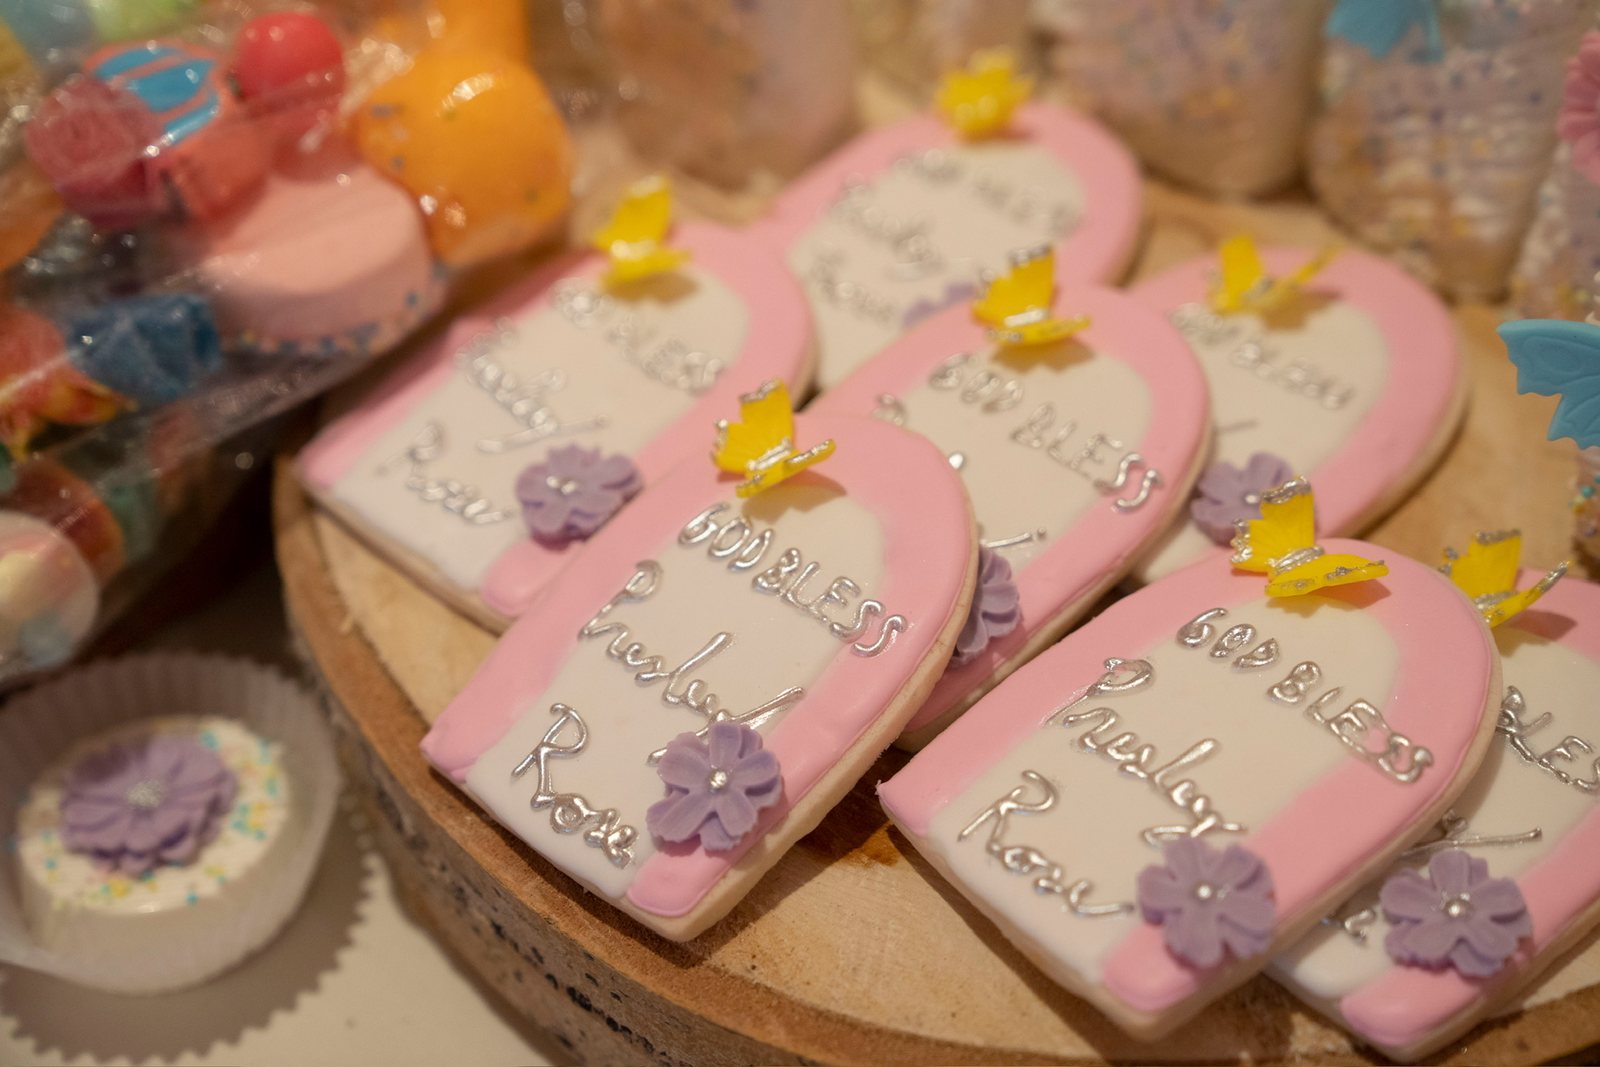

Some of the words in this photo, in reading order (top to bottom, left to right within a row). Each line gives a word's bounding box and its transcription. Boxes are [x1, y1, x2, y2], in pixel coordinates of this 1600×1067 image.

[929, 353, 1024, 413] GOD
[1010, 402, 1163, 511] BLESS
[678, 501, 775, 572] GOD
[752, 546, 908, 658] BLESS
[1176, 607, 1282, 672] GOD
[1266, 660, 1435, 784] BLESS
[510, 702, 639, 870] Rose
[957, 768, 1135, 917] Rose
